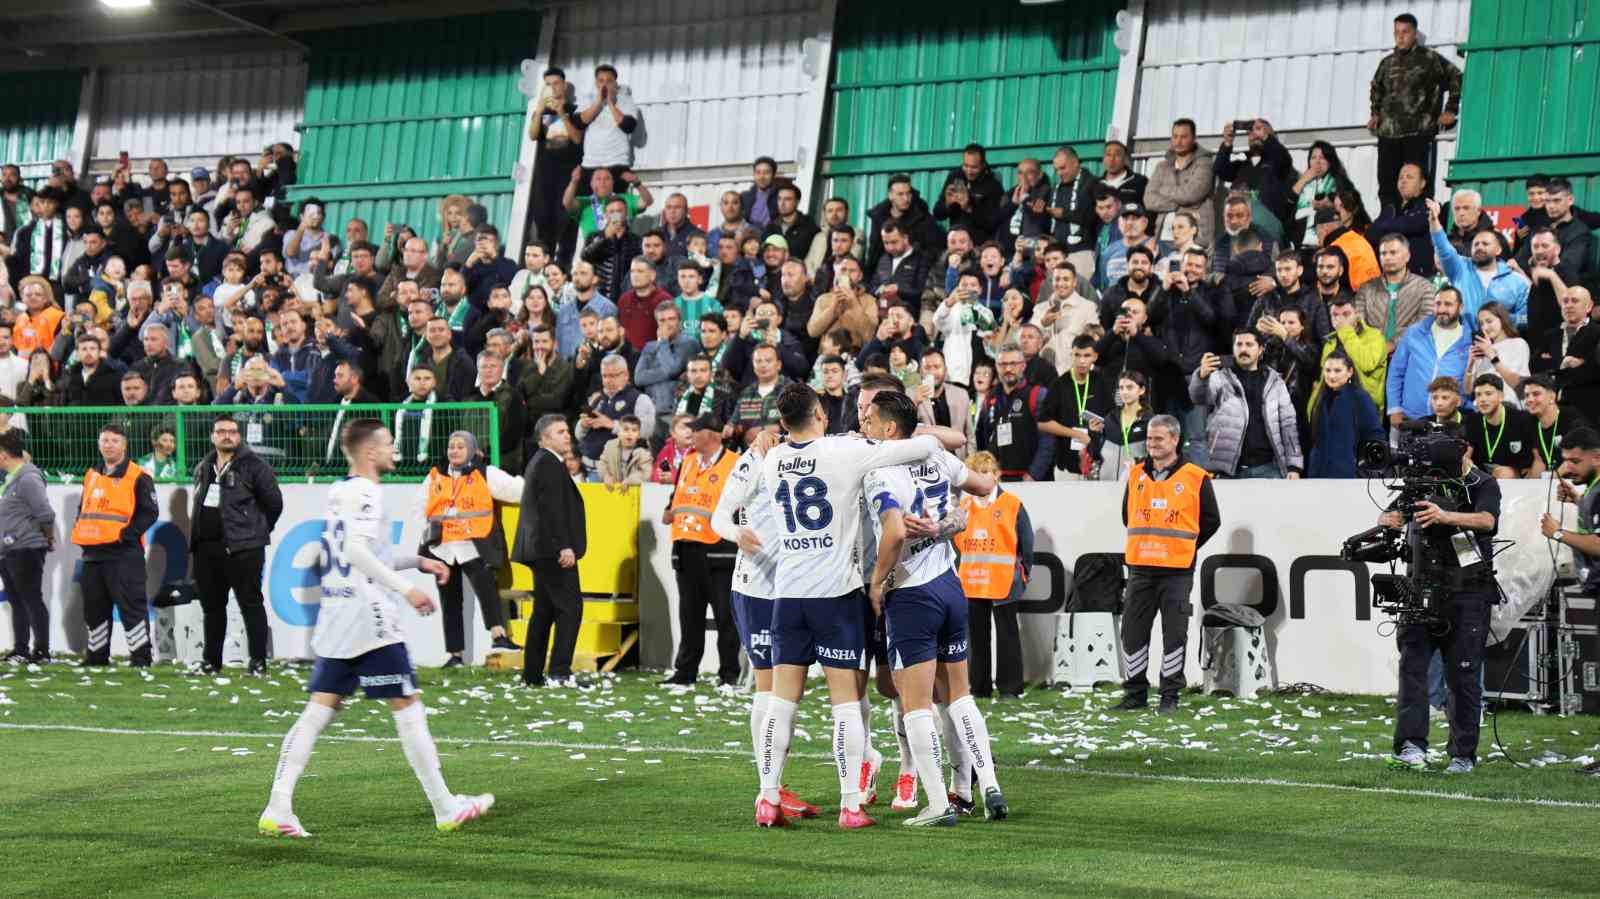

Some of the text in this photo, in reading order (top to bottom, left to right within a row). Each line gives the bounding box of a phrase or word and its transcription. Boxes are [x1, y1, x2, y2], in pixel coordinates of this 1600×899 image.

[777, 456, 816, 476] halley
[774, 476, 834, 533] 18
[783, 533, 833, 551] KOSTIĆ
[819, 646, 857, 660] PASHA
